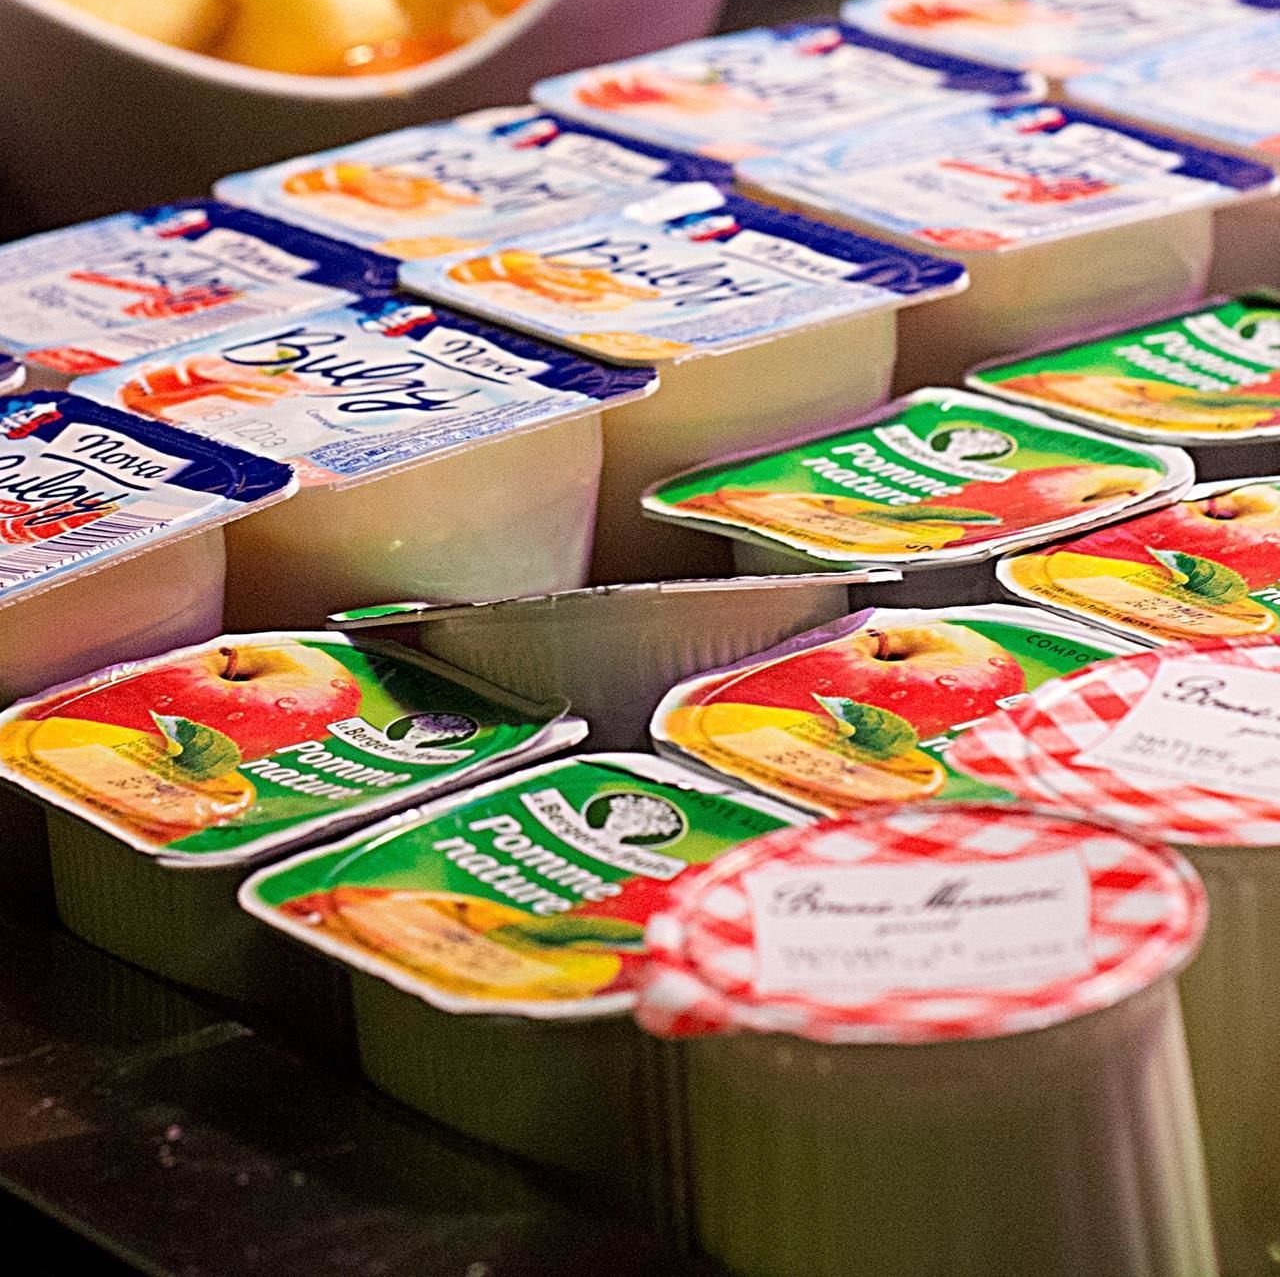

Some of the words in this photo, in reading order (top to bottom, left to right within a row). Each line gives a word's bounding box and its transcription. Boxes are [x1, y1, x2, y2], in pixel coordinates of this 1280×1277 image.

[223, 328, 480, 413] Bulgy
[441, 337, 526, 378] Nova
[71, 433, 169, 480] Nova
[831, 442, 964, 497] Pomme
[801, 457, 922, 506] nature
[276, 738, 412, 787] Pomme
[344, 726, 395, 753] Berger
[238, 756, 363, 800] nature
[432, 836, 573, 915] nature
[468, 814, 623, 902] Pomme
